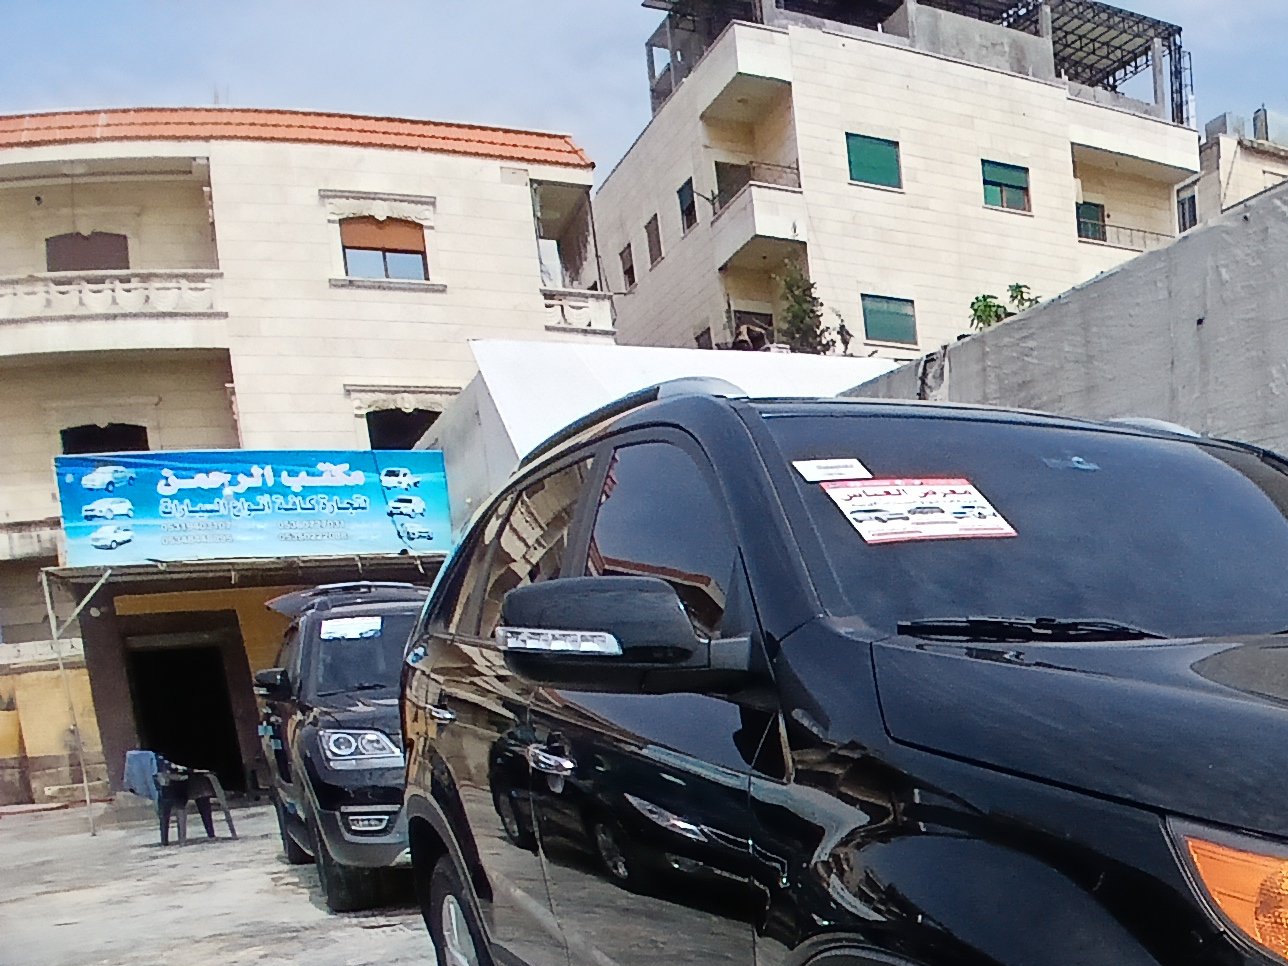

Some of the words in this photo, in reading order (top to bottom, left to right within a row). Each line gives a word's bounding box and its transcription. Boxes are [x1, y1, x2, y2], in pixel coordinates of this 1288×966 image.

[157, 465, 275, 495] الرحمن
[281, 462, 366, 492] مكتب
[274, 495, 318, 513] كافة
